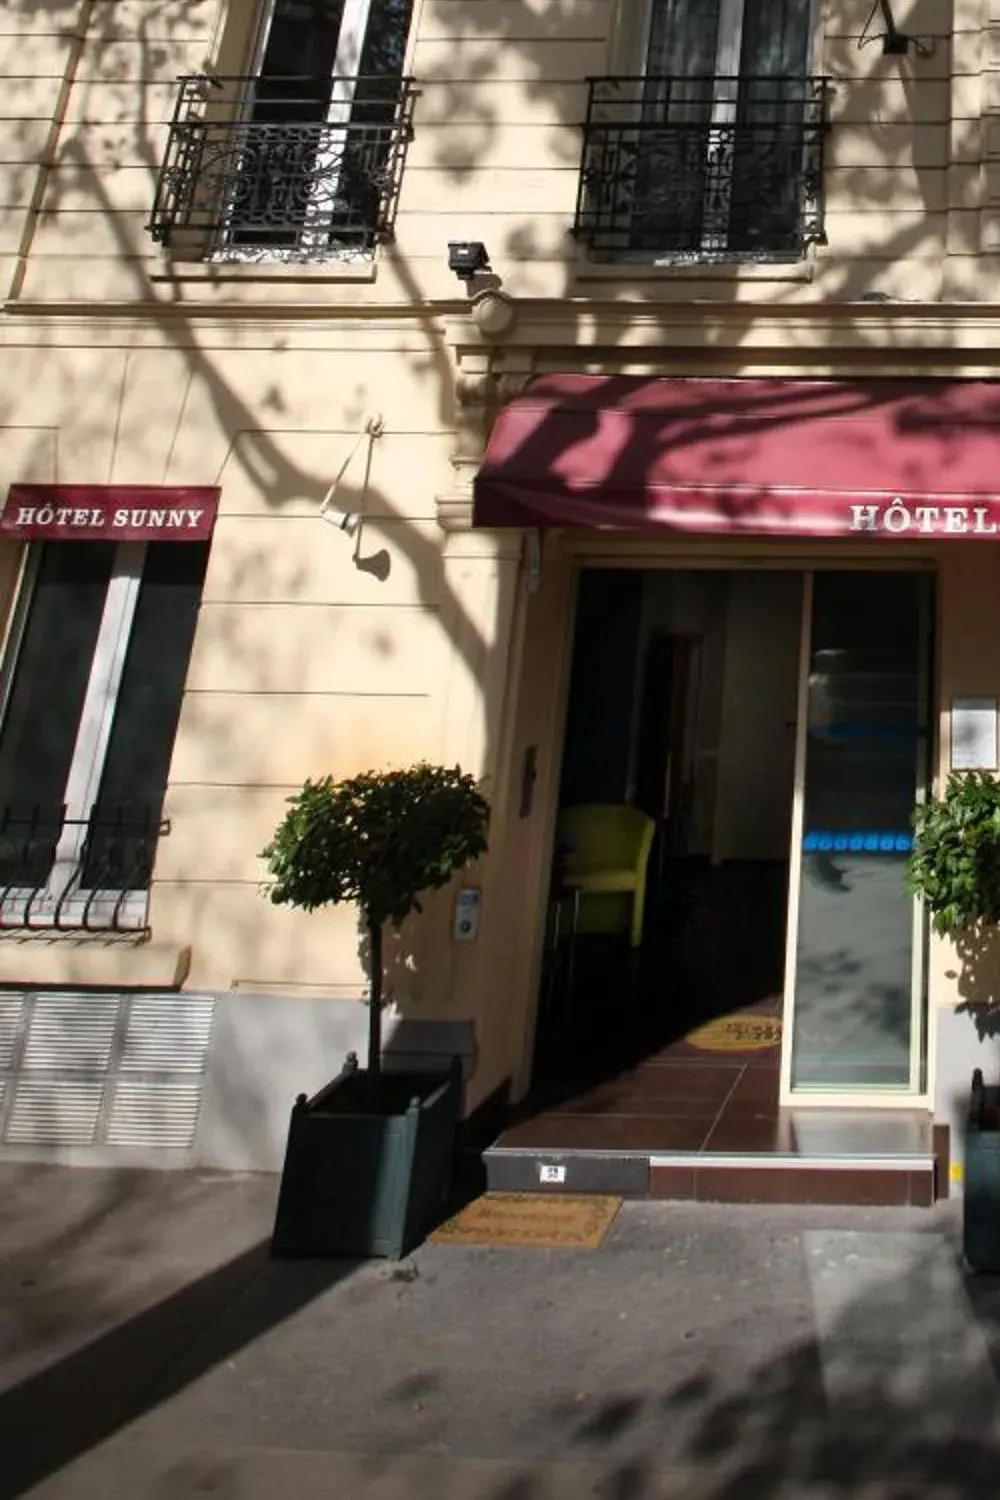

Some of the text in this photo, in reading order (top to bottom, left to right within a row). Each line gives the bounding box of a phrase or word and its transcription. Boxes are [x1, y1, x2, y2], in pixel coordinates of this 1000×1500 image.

[15, 503, 204, 527] HÔTEL SUNNY
[849, 498, 997, 534] HÔTEL
